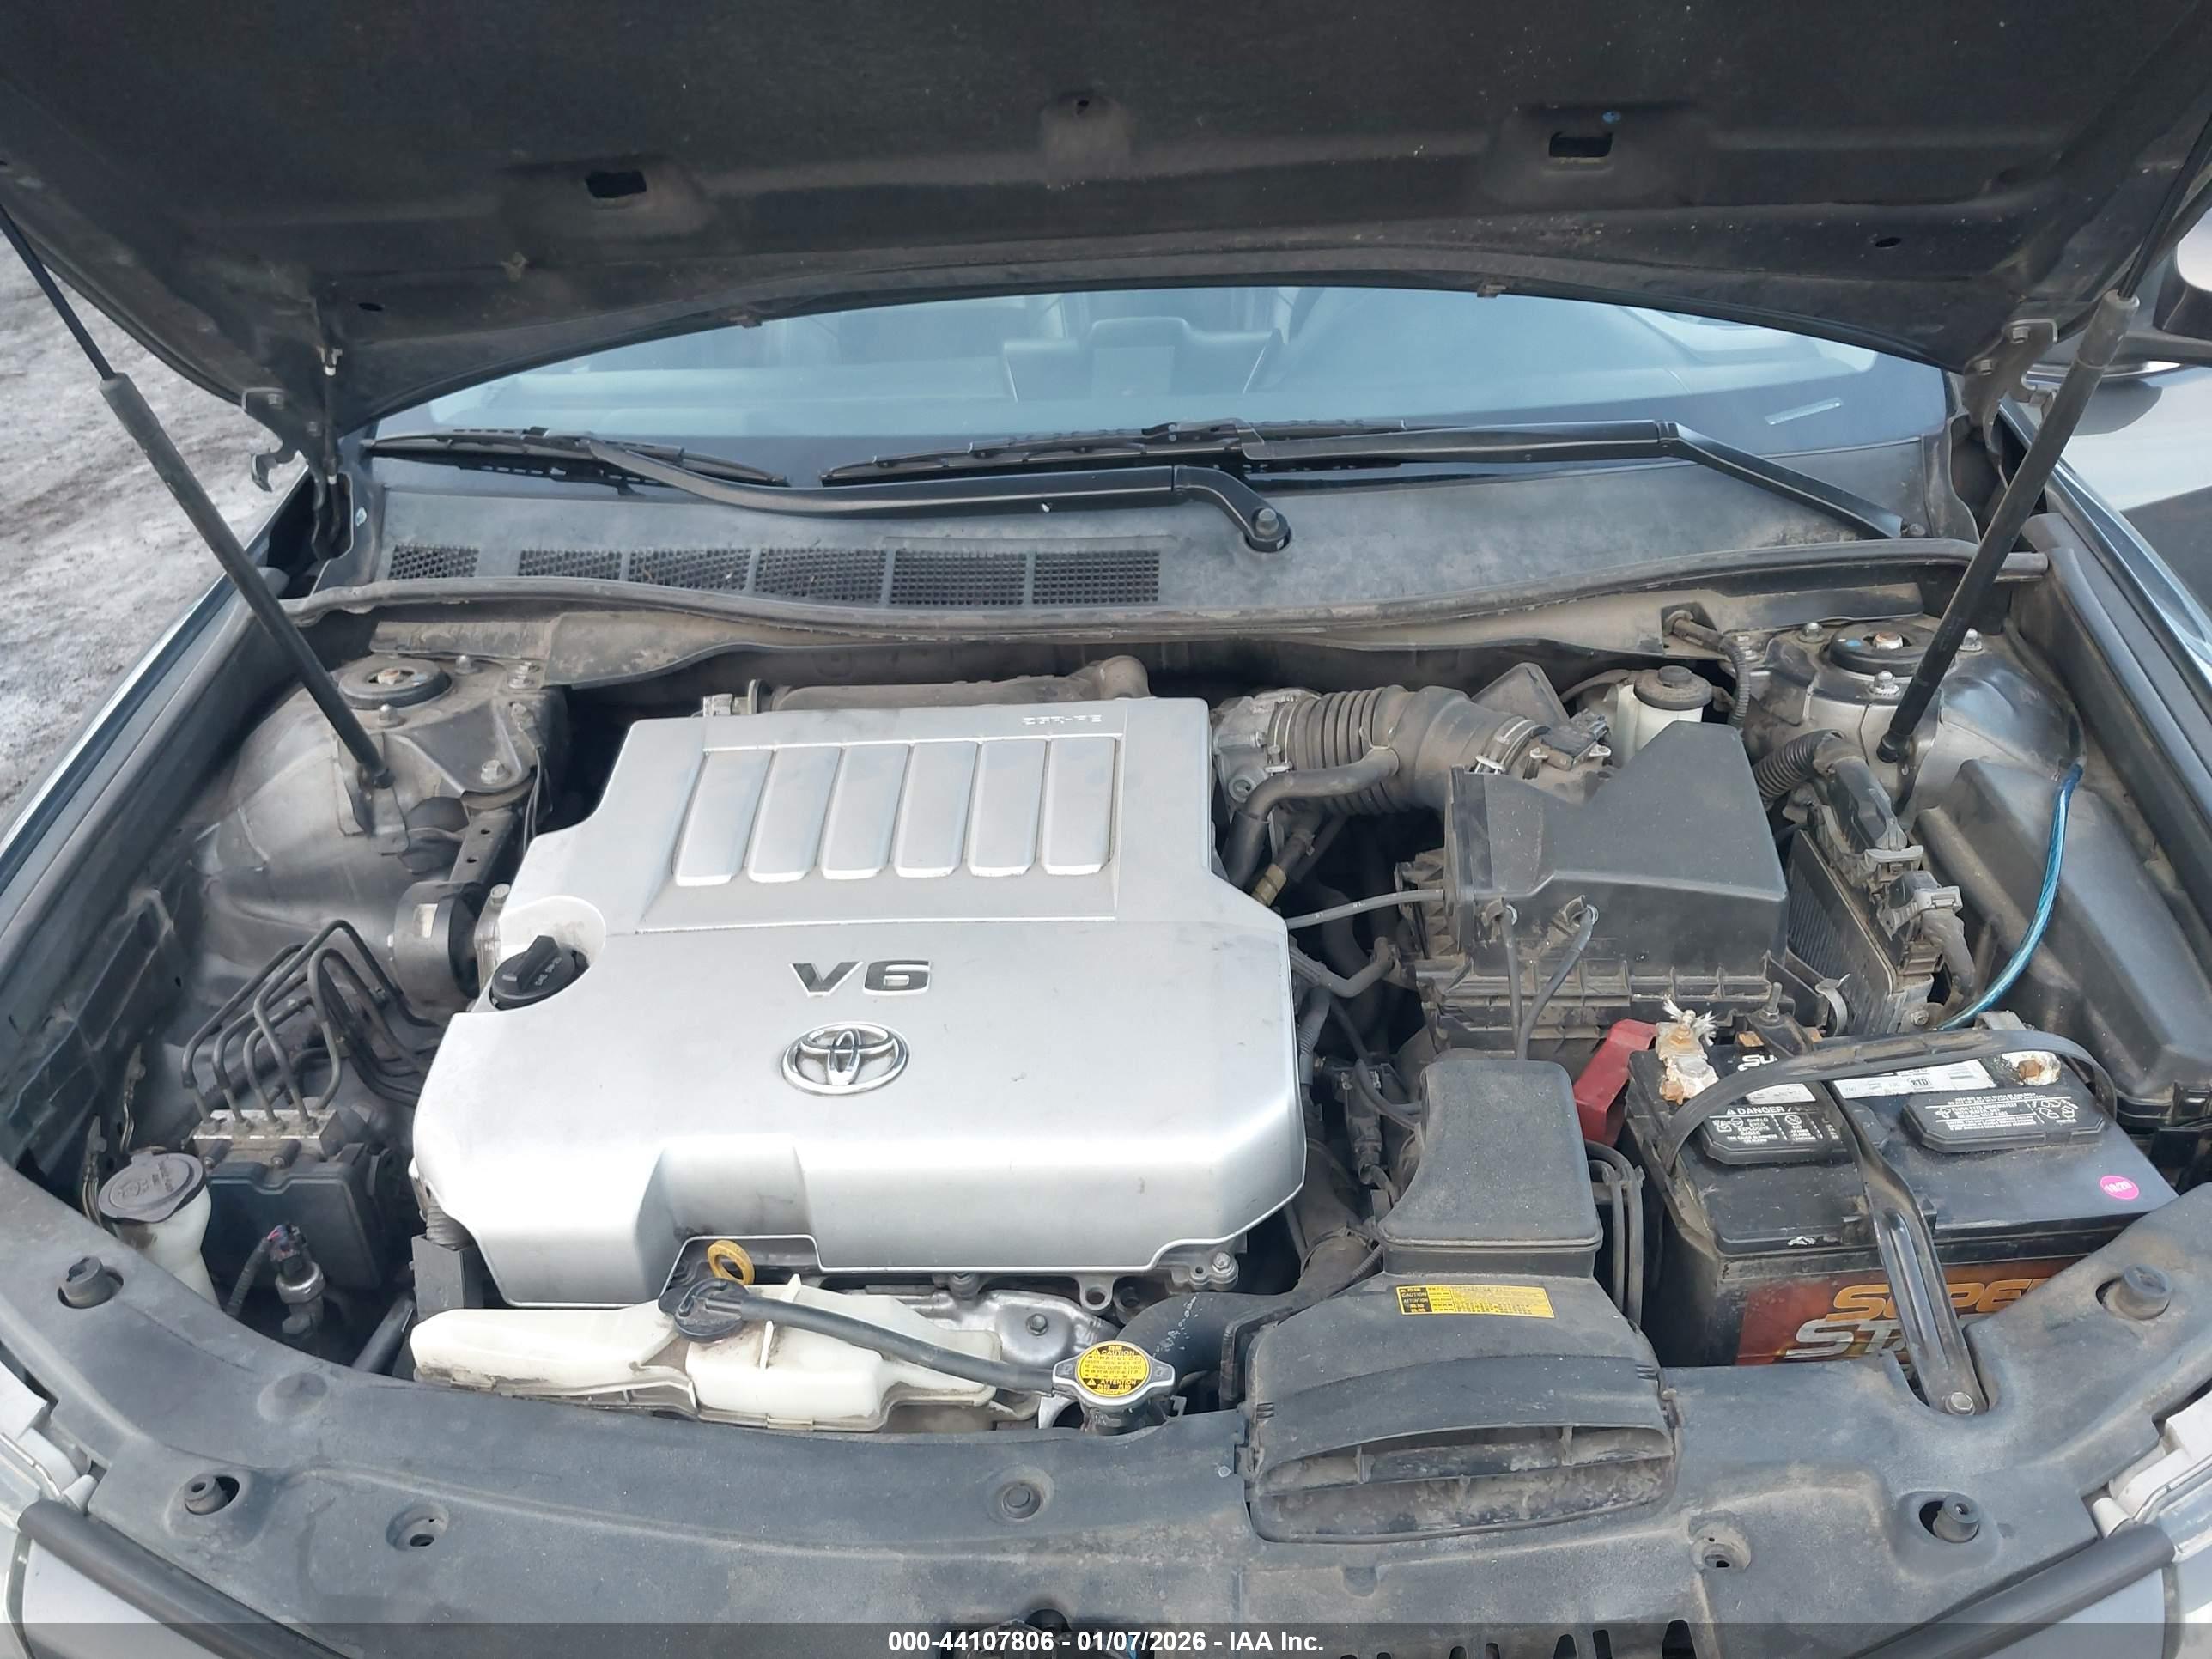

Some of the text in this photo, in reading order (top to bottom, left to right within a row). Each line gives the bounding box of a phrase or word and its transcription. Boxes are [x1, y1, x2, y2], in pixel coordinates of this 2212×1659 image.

[788, 959, 931, 997] V6
[1737, 1106, 1785, 1115] DANGER
[1825, 1278, 2051, 1322] SPE
